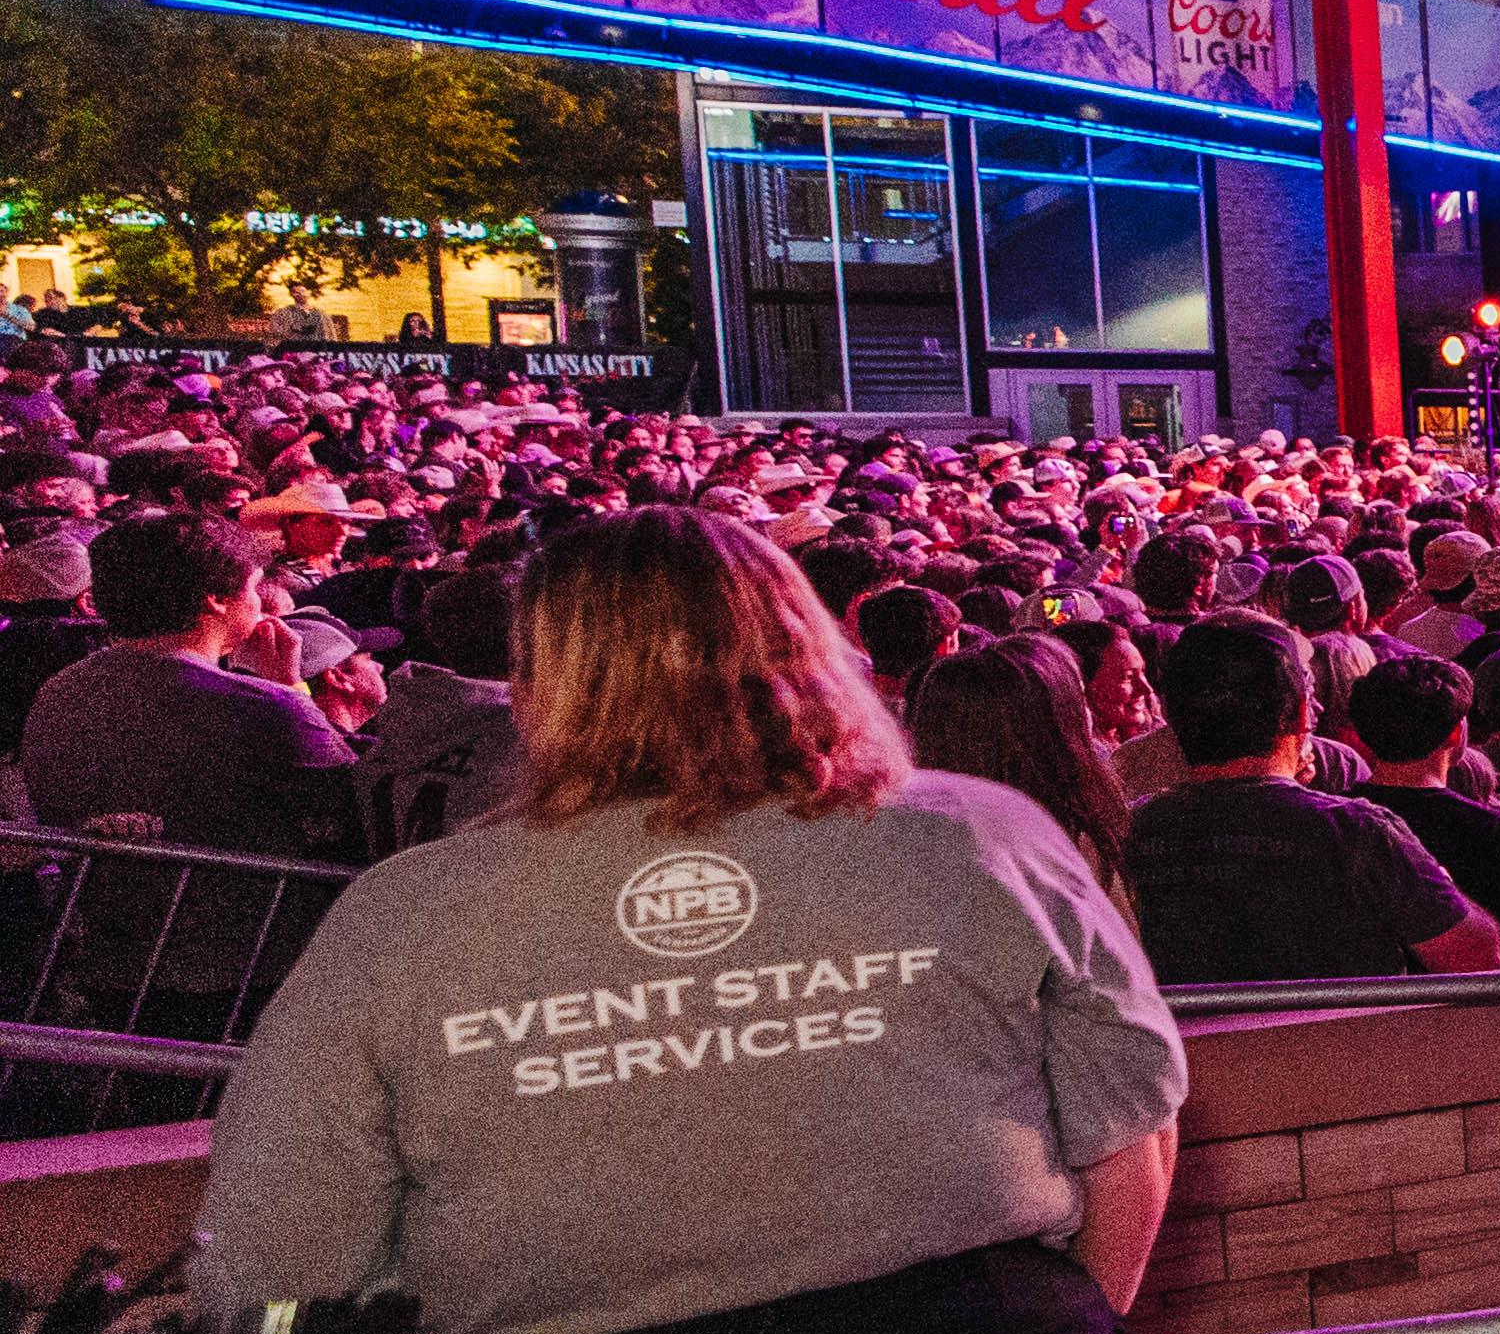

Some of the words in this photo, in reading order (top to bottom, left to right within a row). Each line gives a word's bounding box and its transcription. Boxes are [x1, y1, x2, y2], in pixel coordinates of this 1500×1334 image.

[1177, 36, 1271, 73] LIGHT
[86, 347, 173, 371] KANSA
[525, 353, 606, 377] KANSAS
[636, 885, 741, 924] NPB
[442, 976, 695, 1057] EVENT
[714, 947, 940, 1009] STAFF
[514, 1006, 886, 1097] SERVICES
